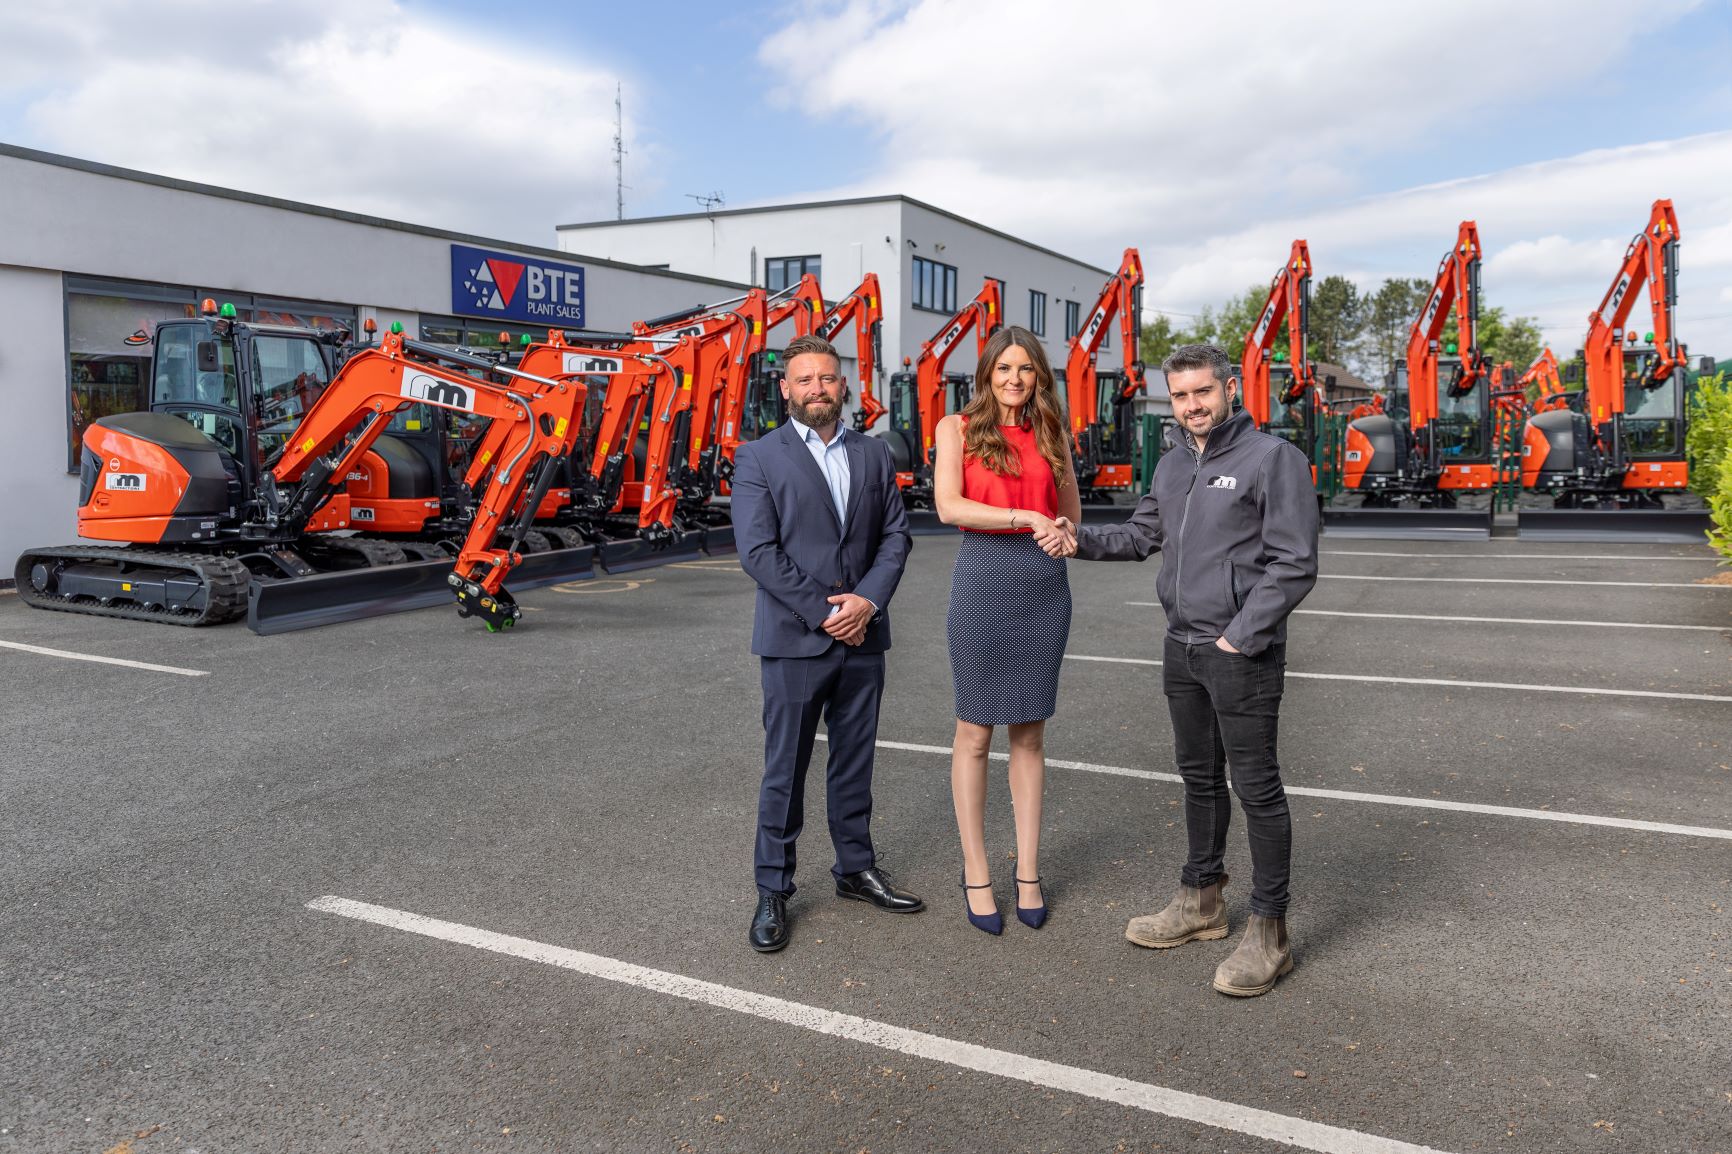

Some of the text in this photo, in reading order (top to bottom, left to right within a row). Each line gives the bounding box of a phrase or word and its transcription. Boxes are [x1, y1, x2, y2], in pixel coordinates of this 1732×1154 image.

[527, 265, 580, 305] BTE
[527, 302, 580, 319] PLANT SALES
